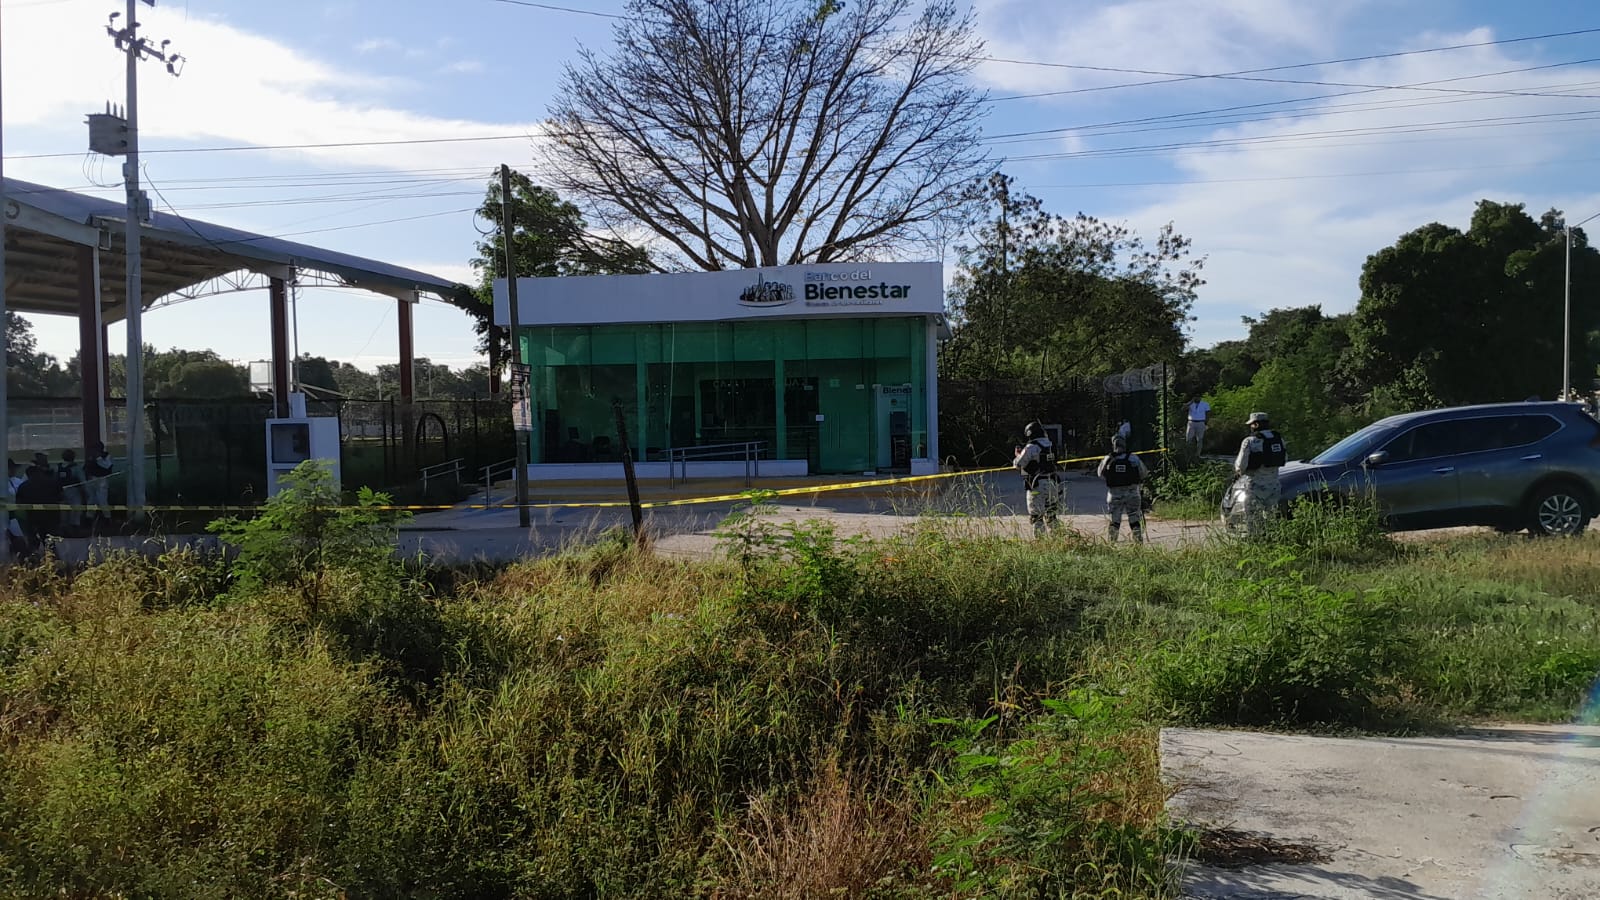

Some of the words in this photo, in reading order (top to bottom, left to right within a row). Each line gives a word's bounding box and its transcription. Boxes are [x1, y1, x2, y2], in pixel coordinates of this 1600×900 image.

[804, 271, 848, 282] Banco
[850, 269, 872, 281] del
[805, 282, 911, 300] Bienestar
